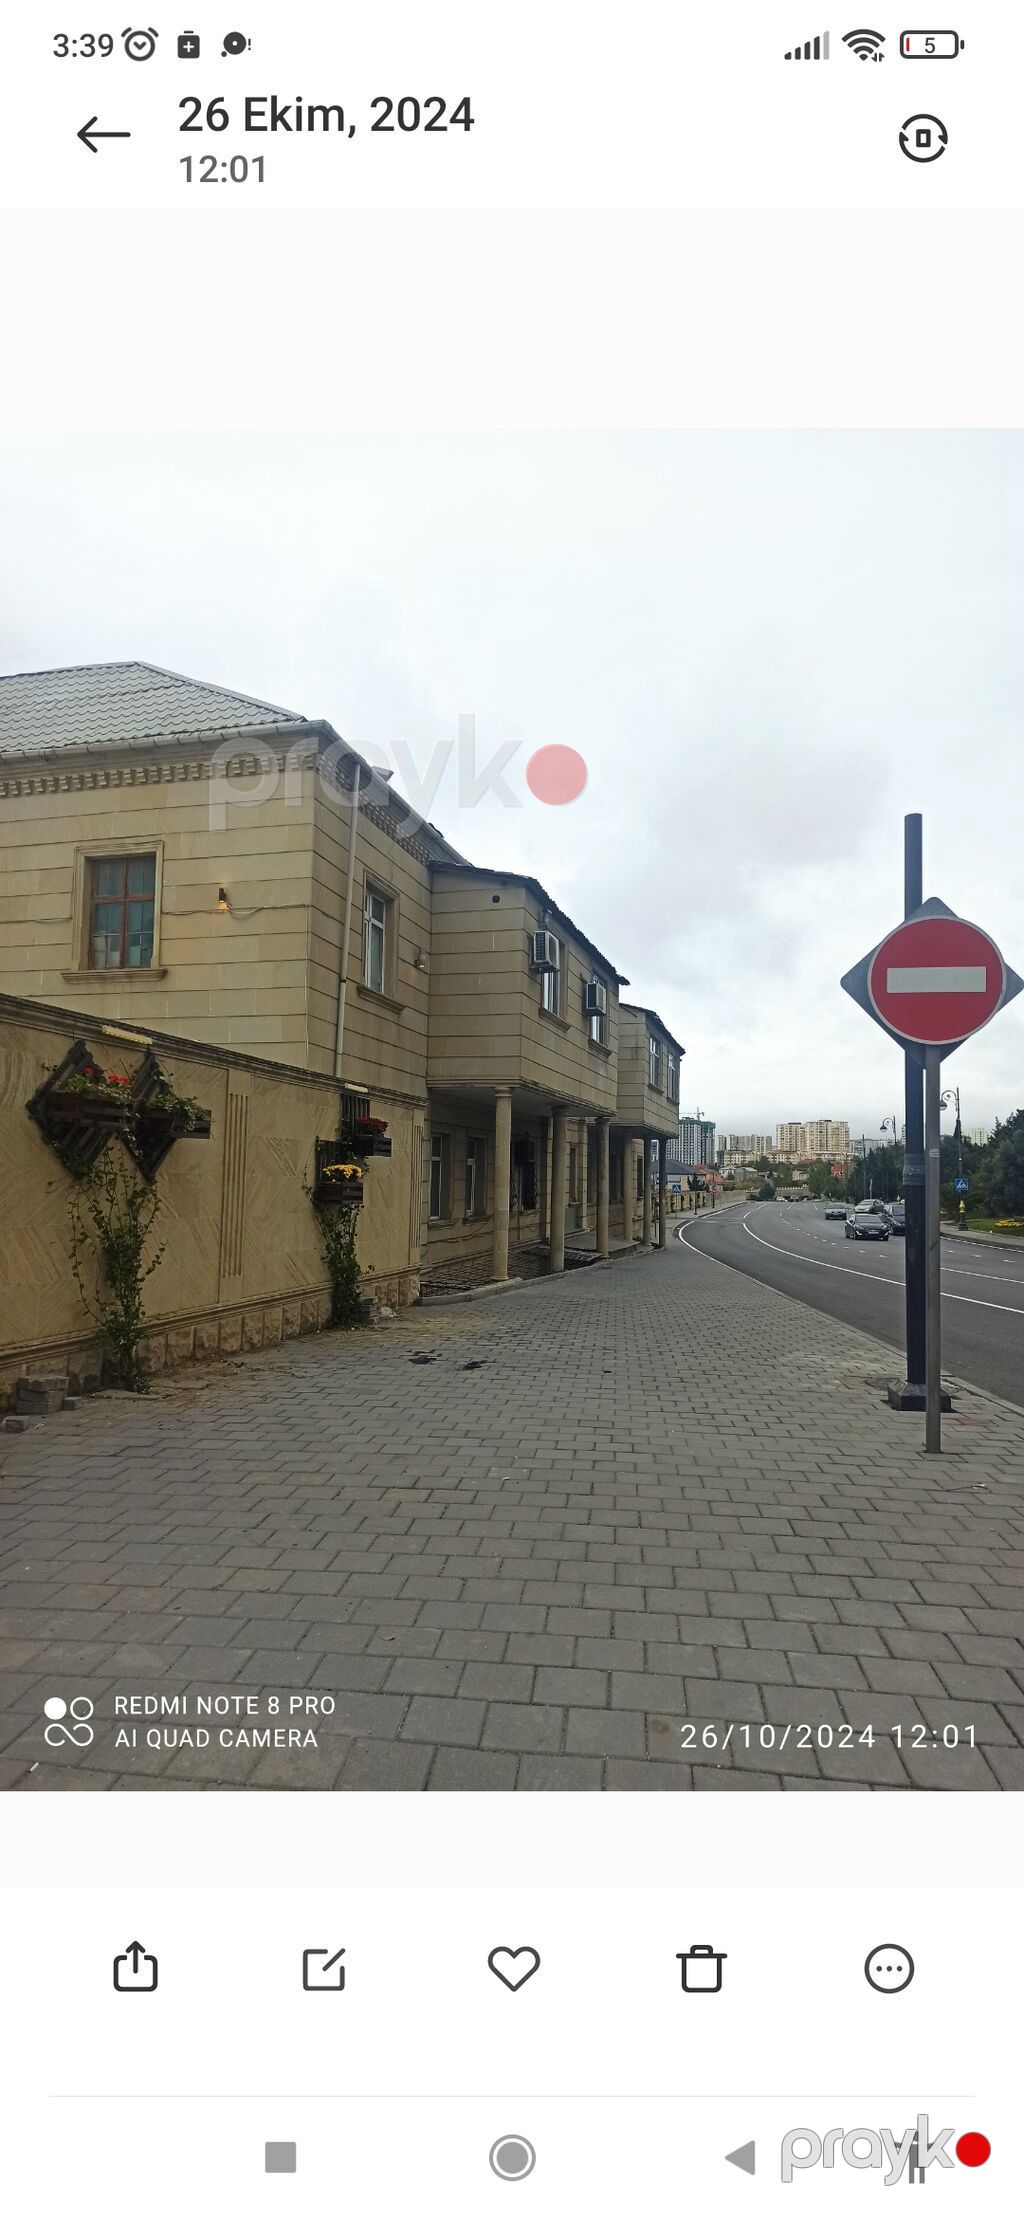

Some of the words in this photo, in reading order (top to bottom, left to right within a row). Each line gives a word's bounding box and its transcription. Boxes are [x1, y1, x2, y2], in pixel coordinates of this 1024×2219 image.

[53, 33, 114, 58] 3:39
[924, 37, 936, 54] 5
[178, 96, 230, 132] 26
[244, 94, 356, 139] Ekim,
[370, 96, 475, 132] 2024
[179, 155, 266, 183] 12:01
